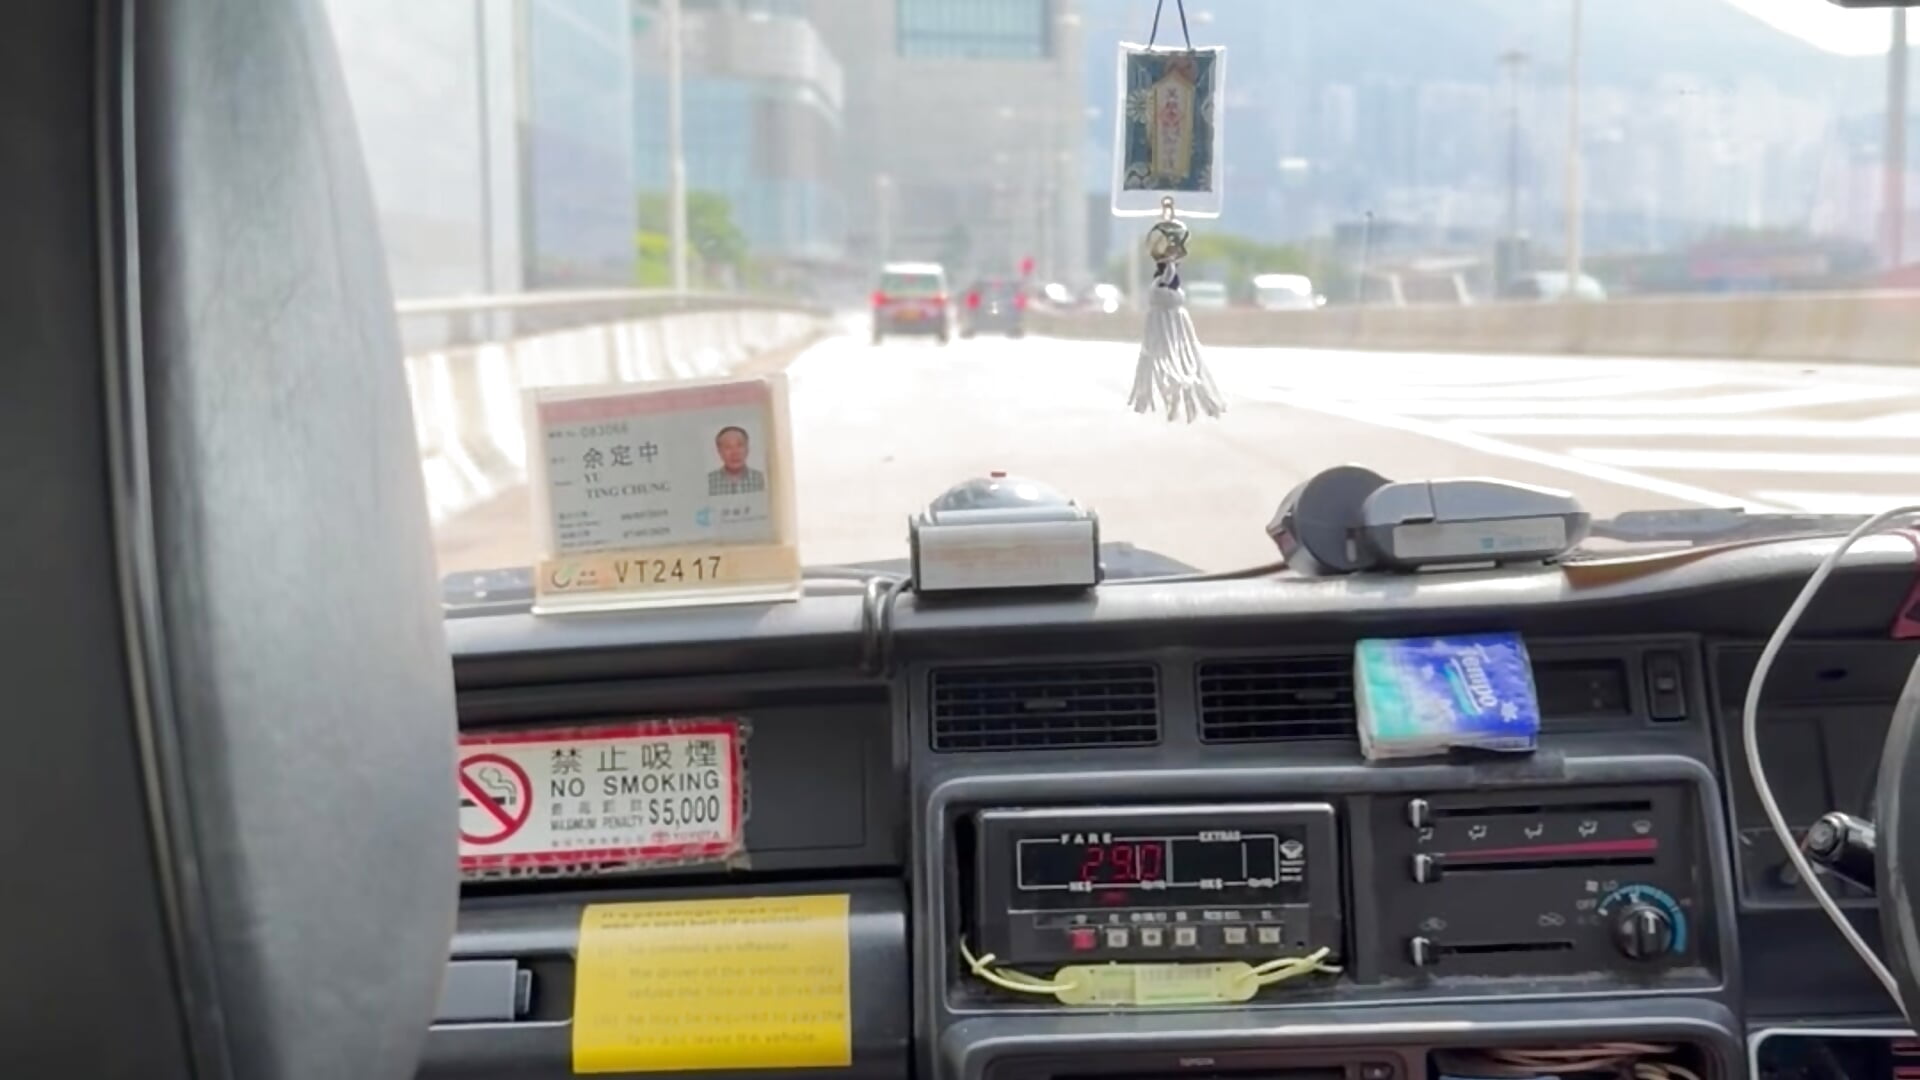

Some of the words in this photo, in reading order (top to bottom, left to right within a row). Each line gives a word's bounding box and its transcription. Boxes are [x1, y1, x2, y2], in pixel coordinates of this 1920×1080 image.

[614, 556, 721, 584] VT2417
[1457, 643, 1498, 707] Tempo
[551, 740, 718, 774] 禁止吸煙
[550, 778, 585, 797] NO
[603, 770, 720, 795] SMOKING
[602, 814, 643, 829] PENALTY
[649, 795, 720, 829] $5,000
[1060, 833, 1112, 845] FARE
